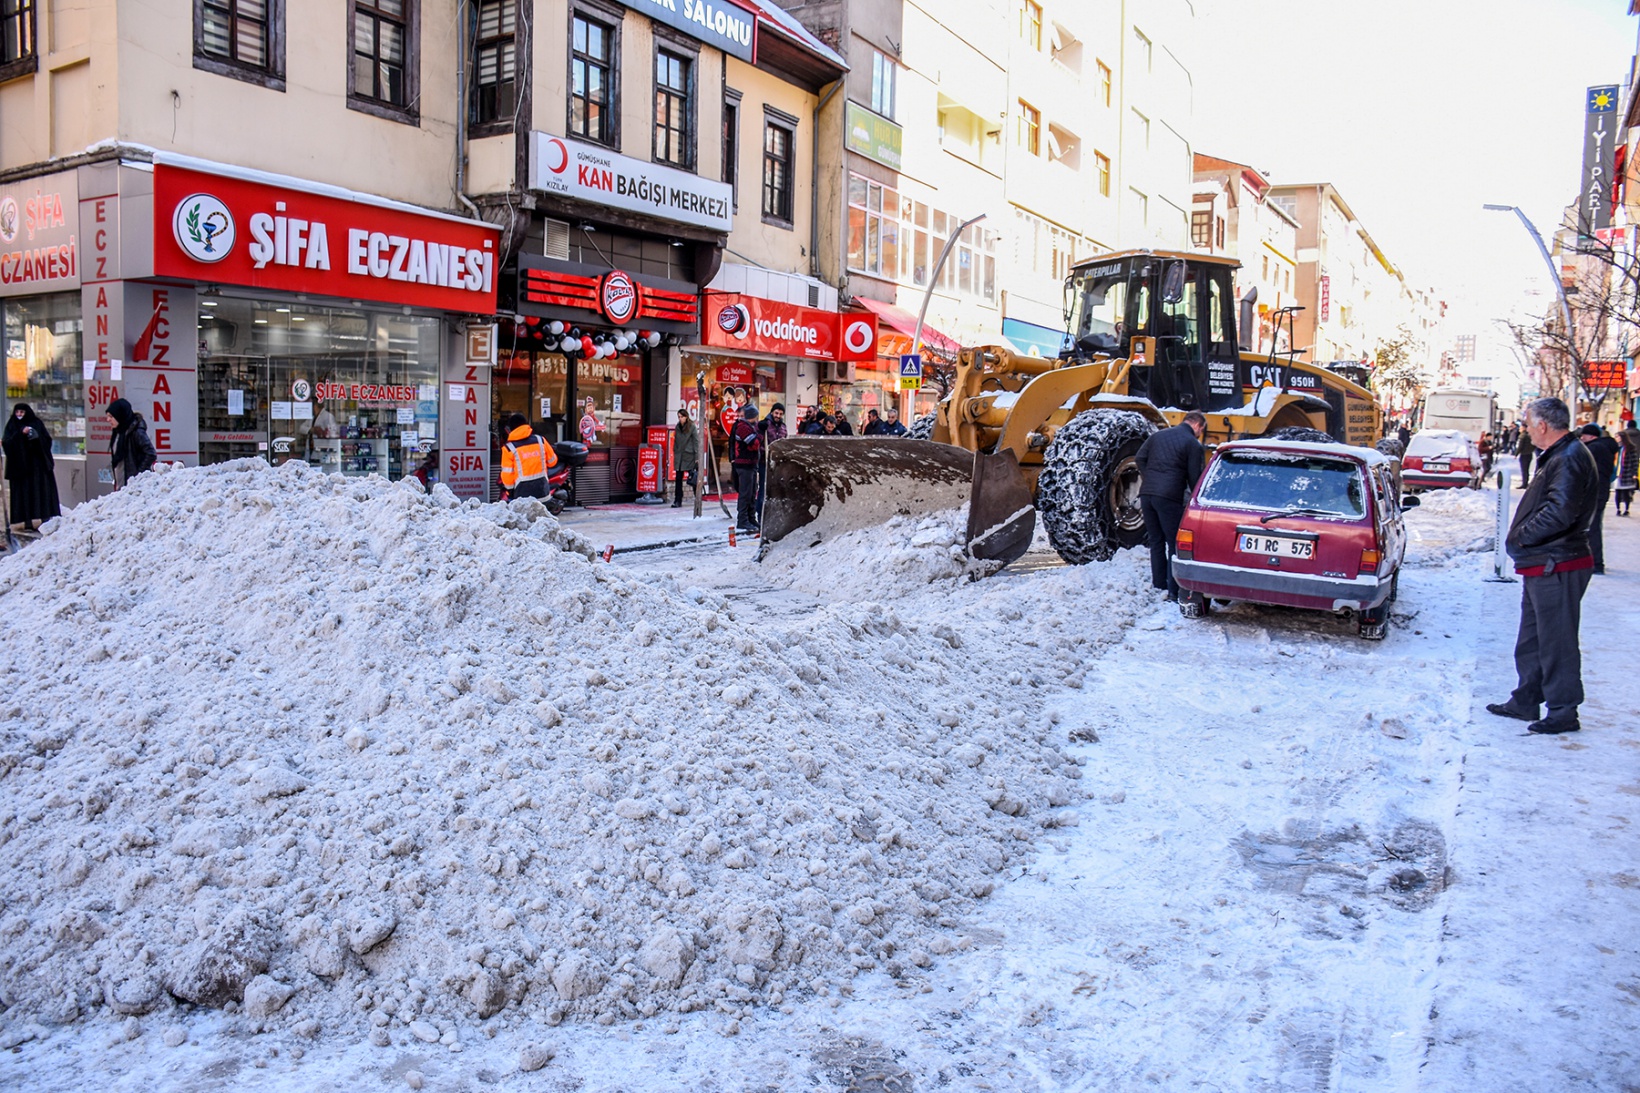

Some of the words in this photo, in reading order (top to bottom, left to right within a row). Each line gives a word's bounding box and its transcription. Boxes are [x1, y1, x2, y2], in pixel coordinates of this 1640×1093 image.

[683, 0, 751, 47] SALONU
[1592, 115, 1607, 163] İYİ
[577, 152, 611, 168] GÜMÜŞHANE
[546, 180, 569, 192] KIZILAY
[578, 163, 613, 193] KAN
[616, 174, 667, 207] BAĞIŞI
[670, 187, 728, 220] MERKEZİ
[25, 189, 66, 241] ŞİFA
[249, 201, 331, 270] ŞİFA
[347, 228, 494, 294] ECZANESİ
[95, 200, 109, 365] ECZANE
[1083, 262, 1122, 280] CATERPILLAR
[472, 332, 489, 357] E
[753, 316, 818, 345] vodafone
[152, 289, 172, 450] ECZANE
[1250, 365, 1282, 388] CAT
[1290, 376, 1315, 388] 950H
[88, 381, 119, 410] ŞİFA
[315, 379, 347, 403] ŞİFA
[351, 383, 417, 401] ECZANESİ
[449, 452, 484, 475] ŞİFA
[1245, 537, 1259, 550] 61
[1264, 539, 1279, 553] RC
[1291, 542, 1312, 556] 575
